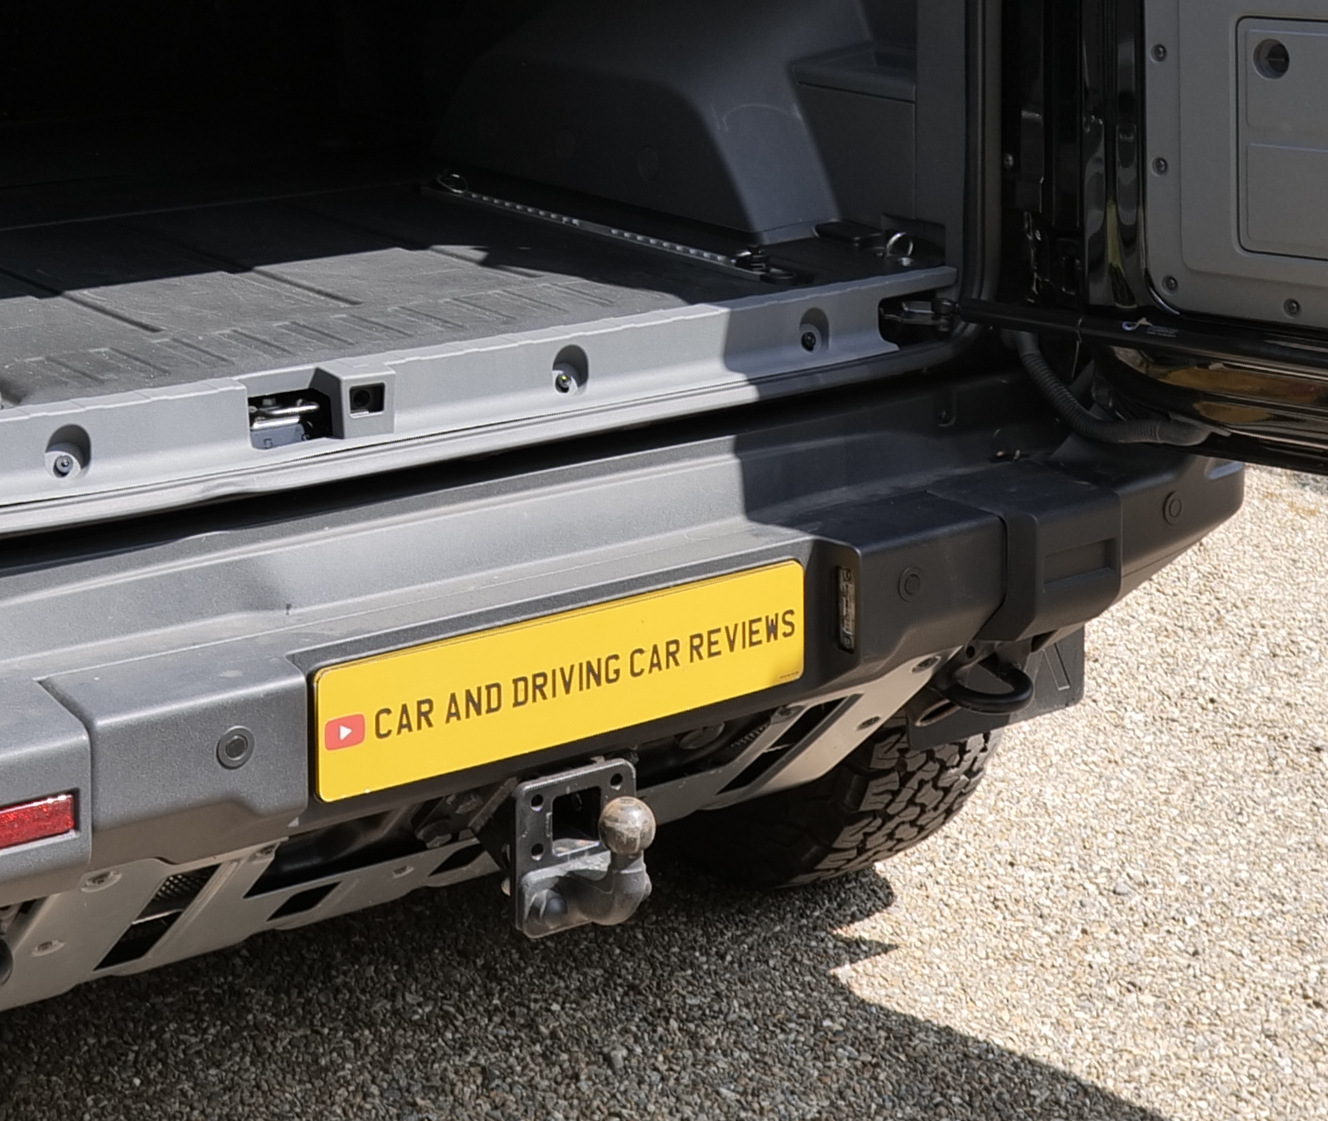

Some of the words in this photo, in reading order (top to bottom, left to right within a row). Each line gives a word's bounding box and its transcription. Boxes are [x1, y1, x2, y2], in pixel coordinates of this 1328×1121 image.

[375, 698, 434, 739] CAR
[446, 682, 502, 723] AND
[512, 654, 620, 707] DRIVING
[630, 639, 680, 677] CAR
[690, 609, 796, 663] REVIEWS
